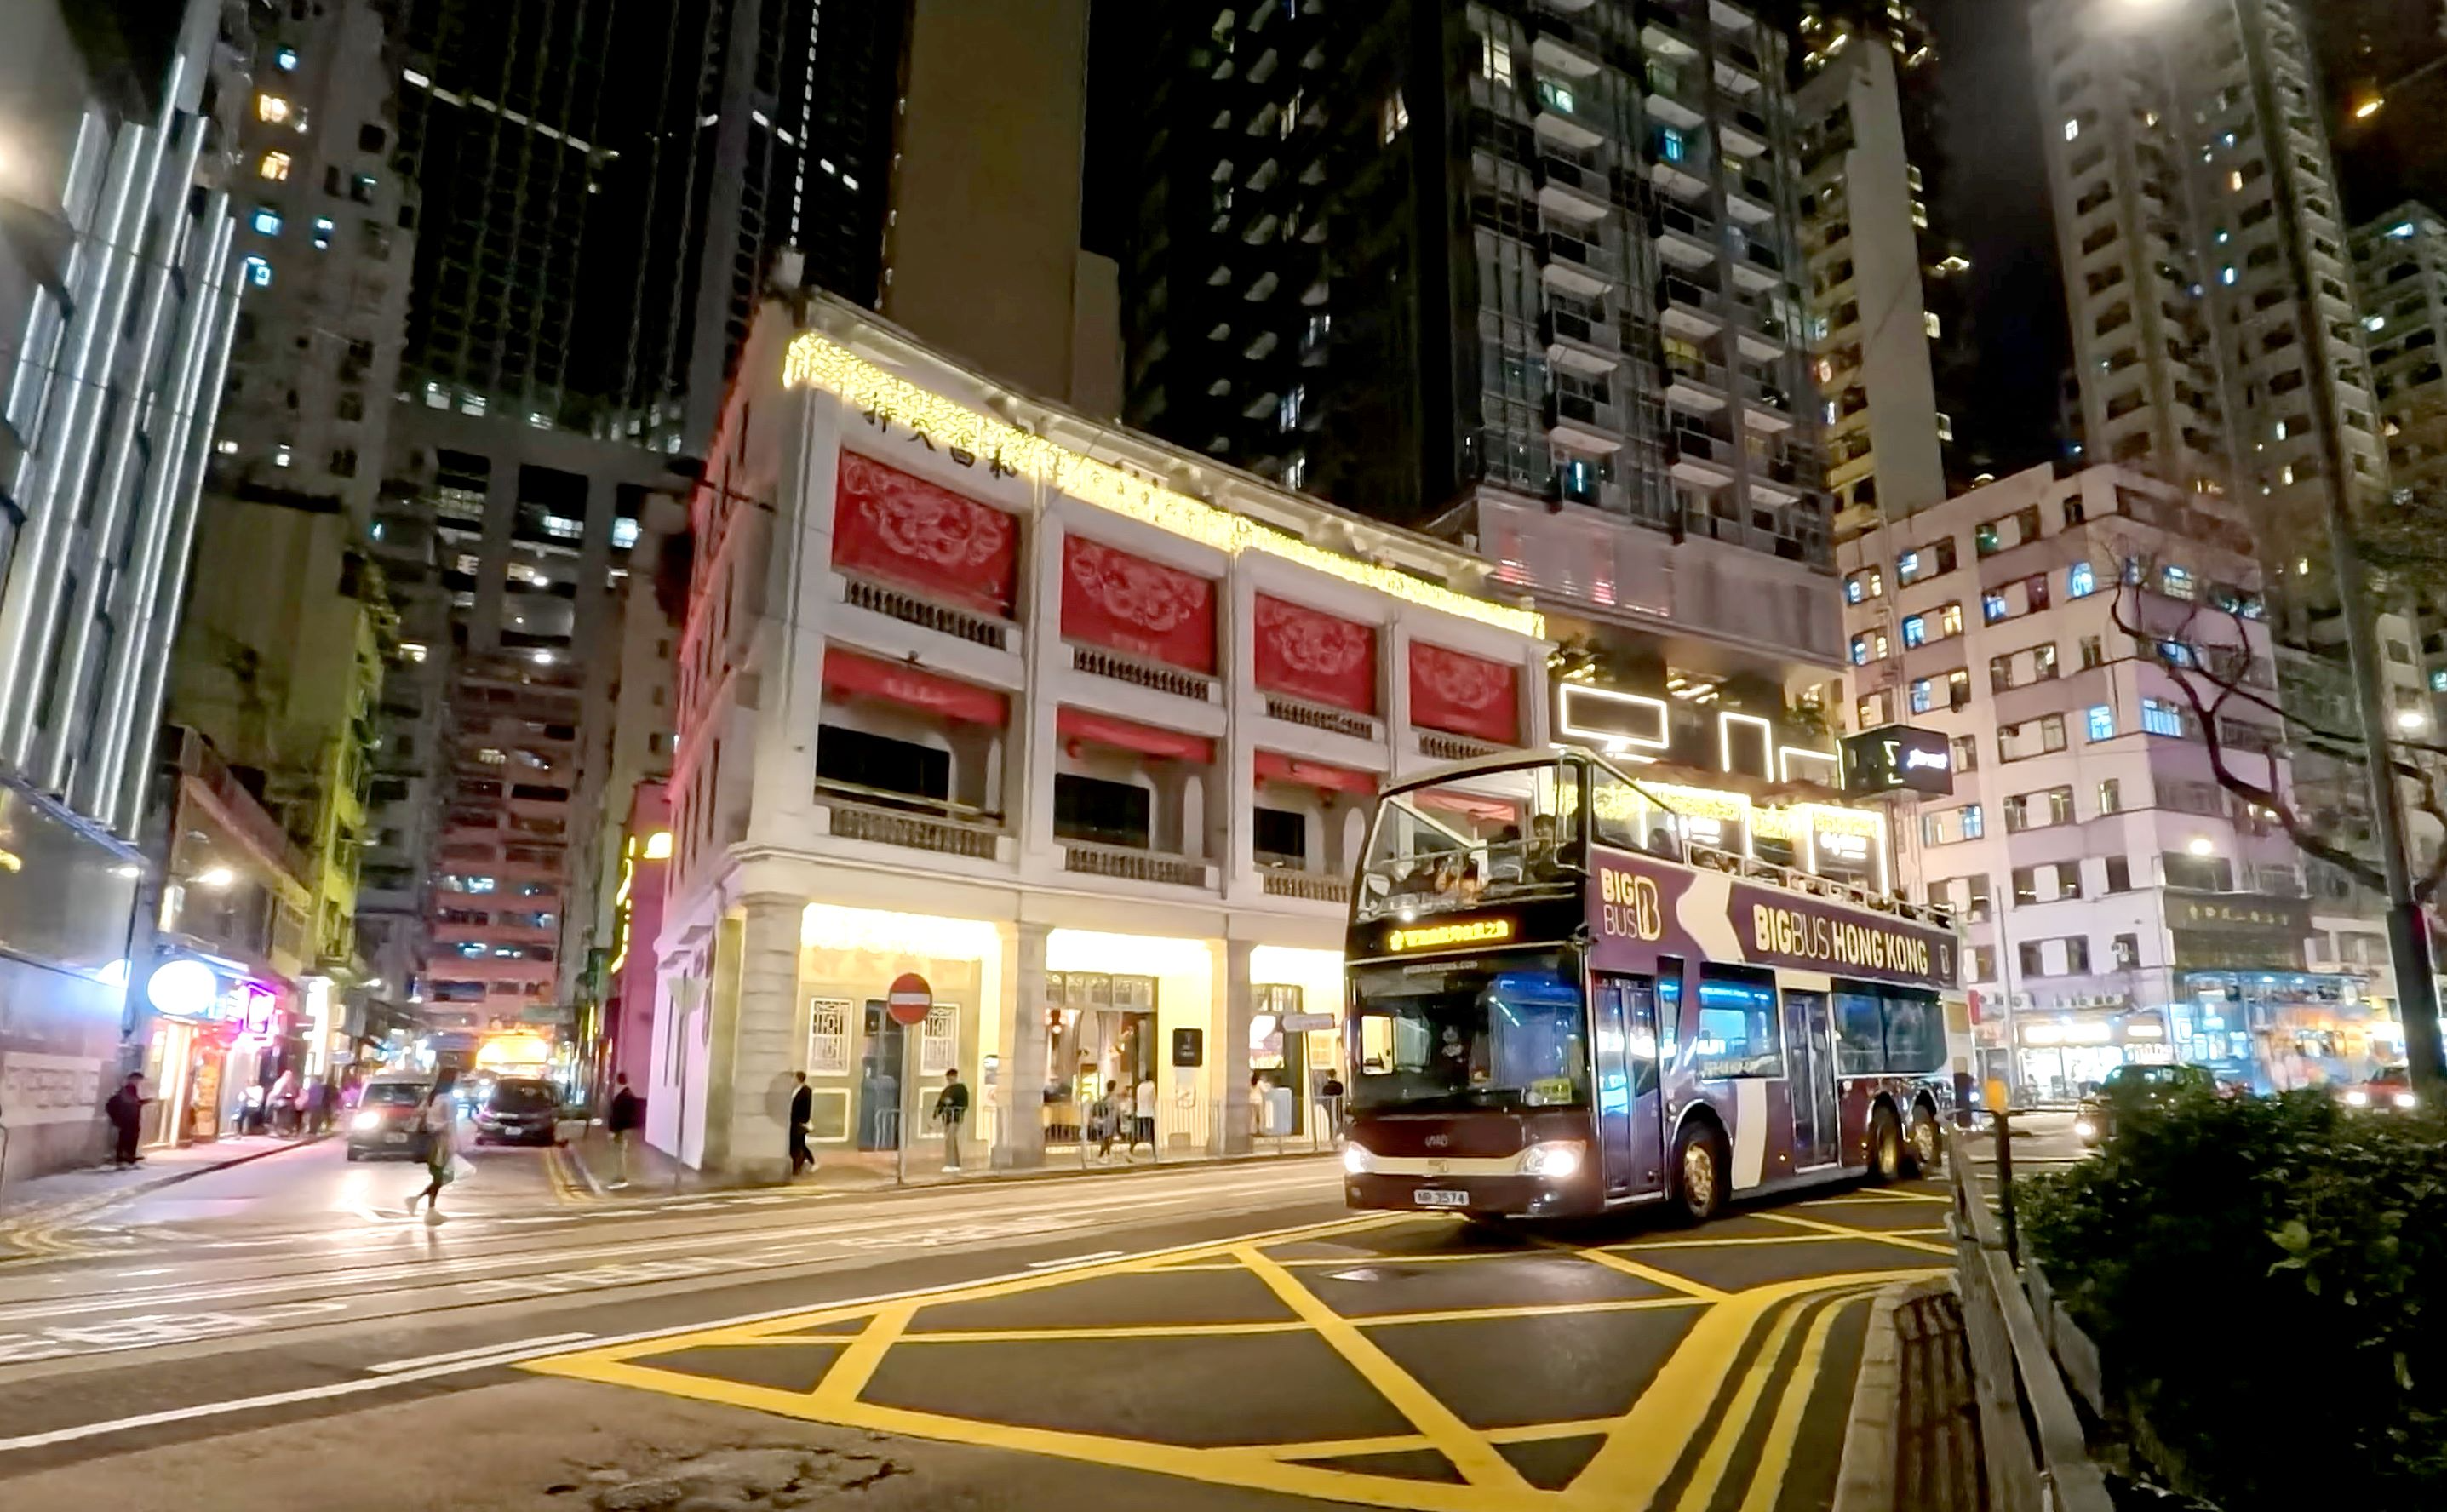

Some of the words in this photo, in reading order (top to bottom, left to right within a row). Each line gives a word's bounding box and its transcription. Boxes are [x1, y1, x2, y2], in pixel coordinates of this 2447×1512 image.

[1600, 868, 1635, 906] BIG
[1603, 903, 1638, 939] BUS
[1831, 920, 1883, 969] HONG
[1885, 932, 1929, 976] KONG
